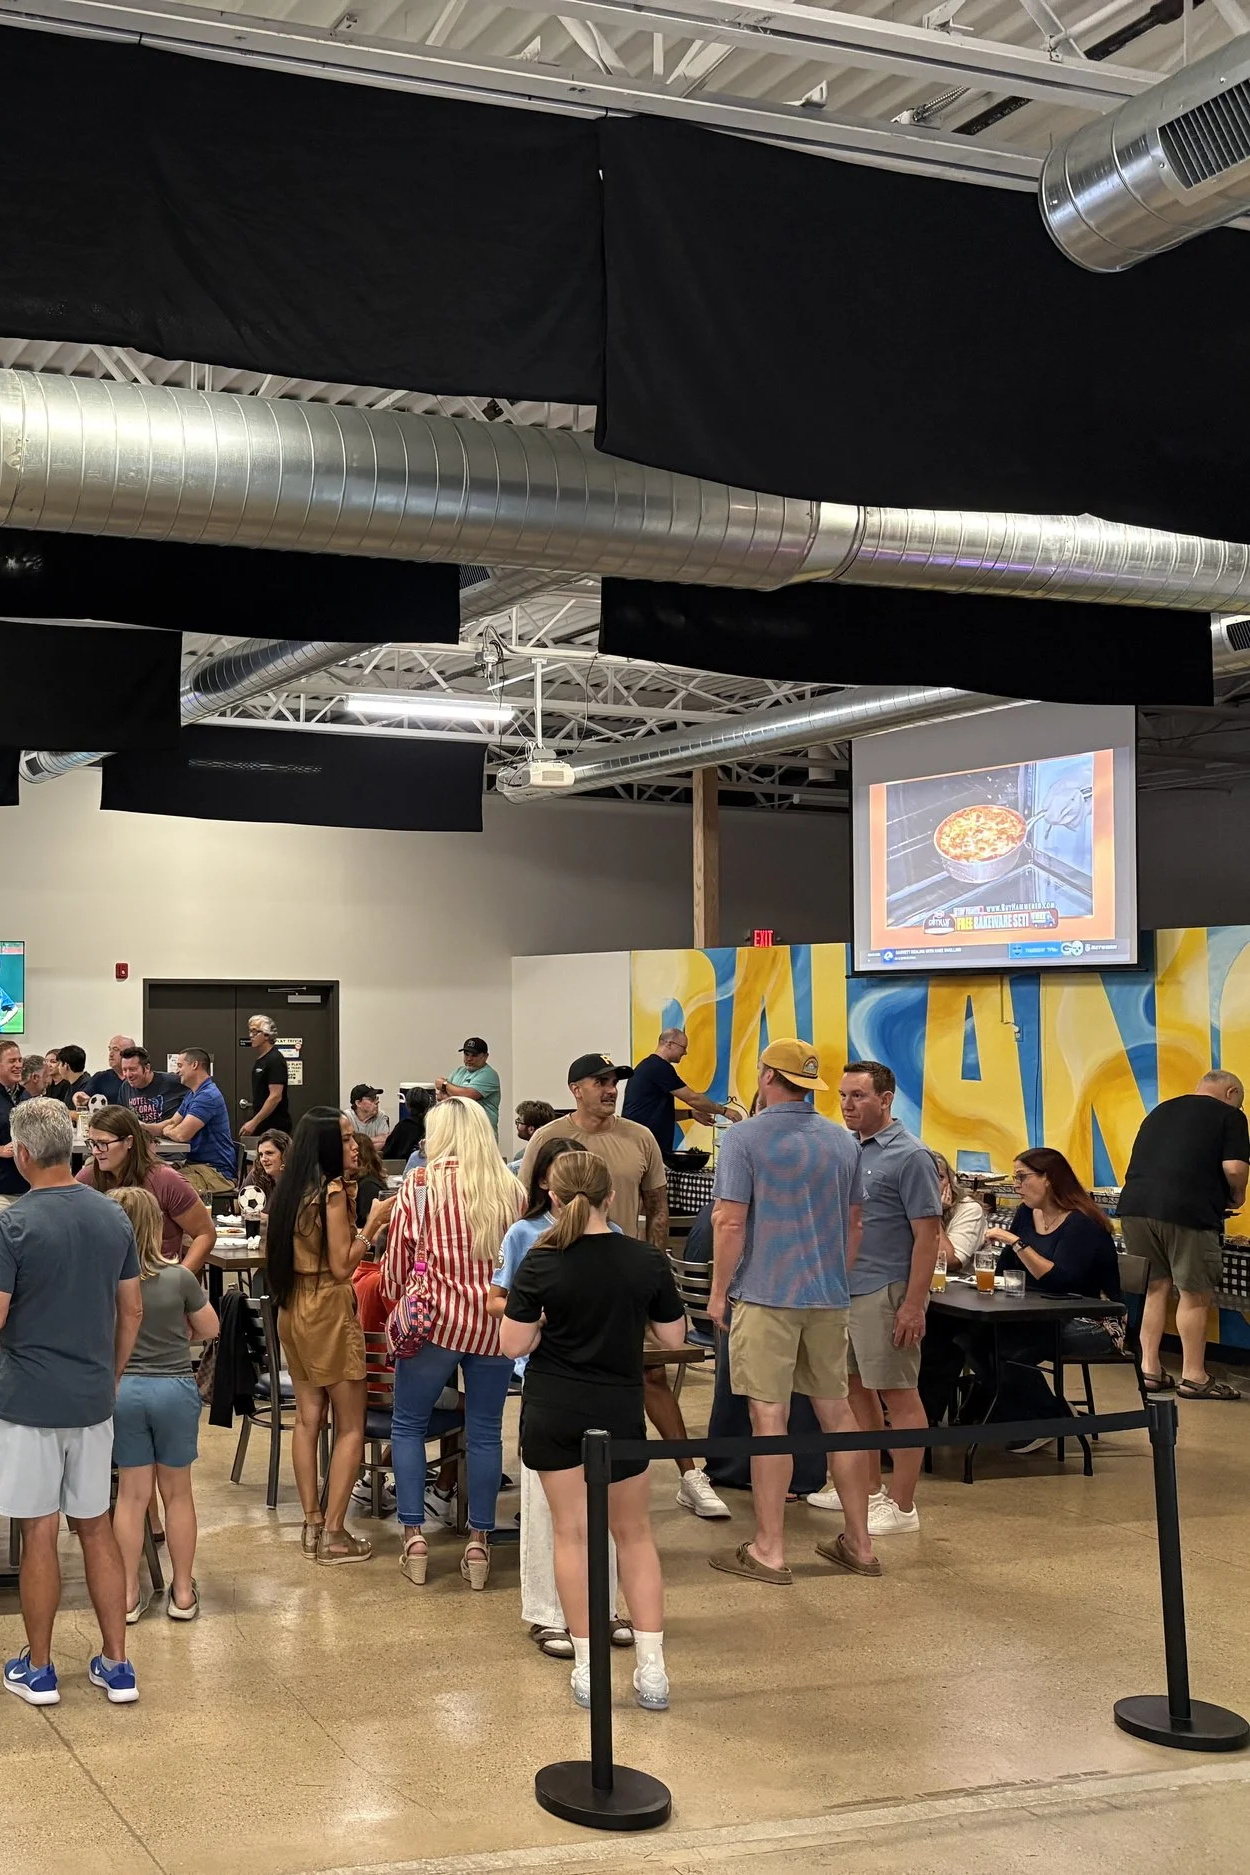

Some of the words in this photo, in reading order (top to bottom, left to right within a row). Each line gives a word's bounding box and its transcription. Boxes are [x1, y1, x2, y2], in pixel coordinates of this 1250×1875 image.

[956, 917, 973, 931] FREE
[974, 914, 1012, 930] BAKEWARE
[754, 930, 774, 947] EXIT
[128, 1096, 148, 1106] HOTEL
